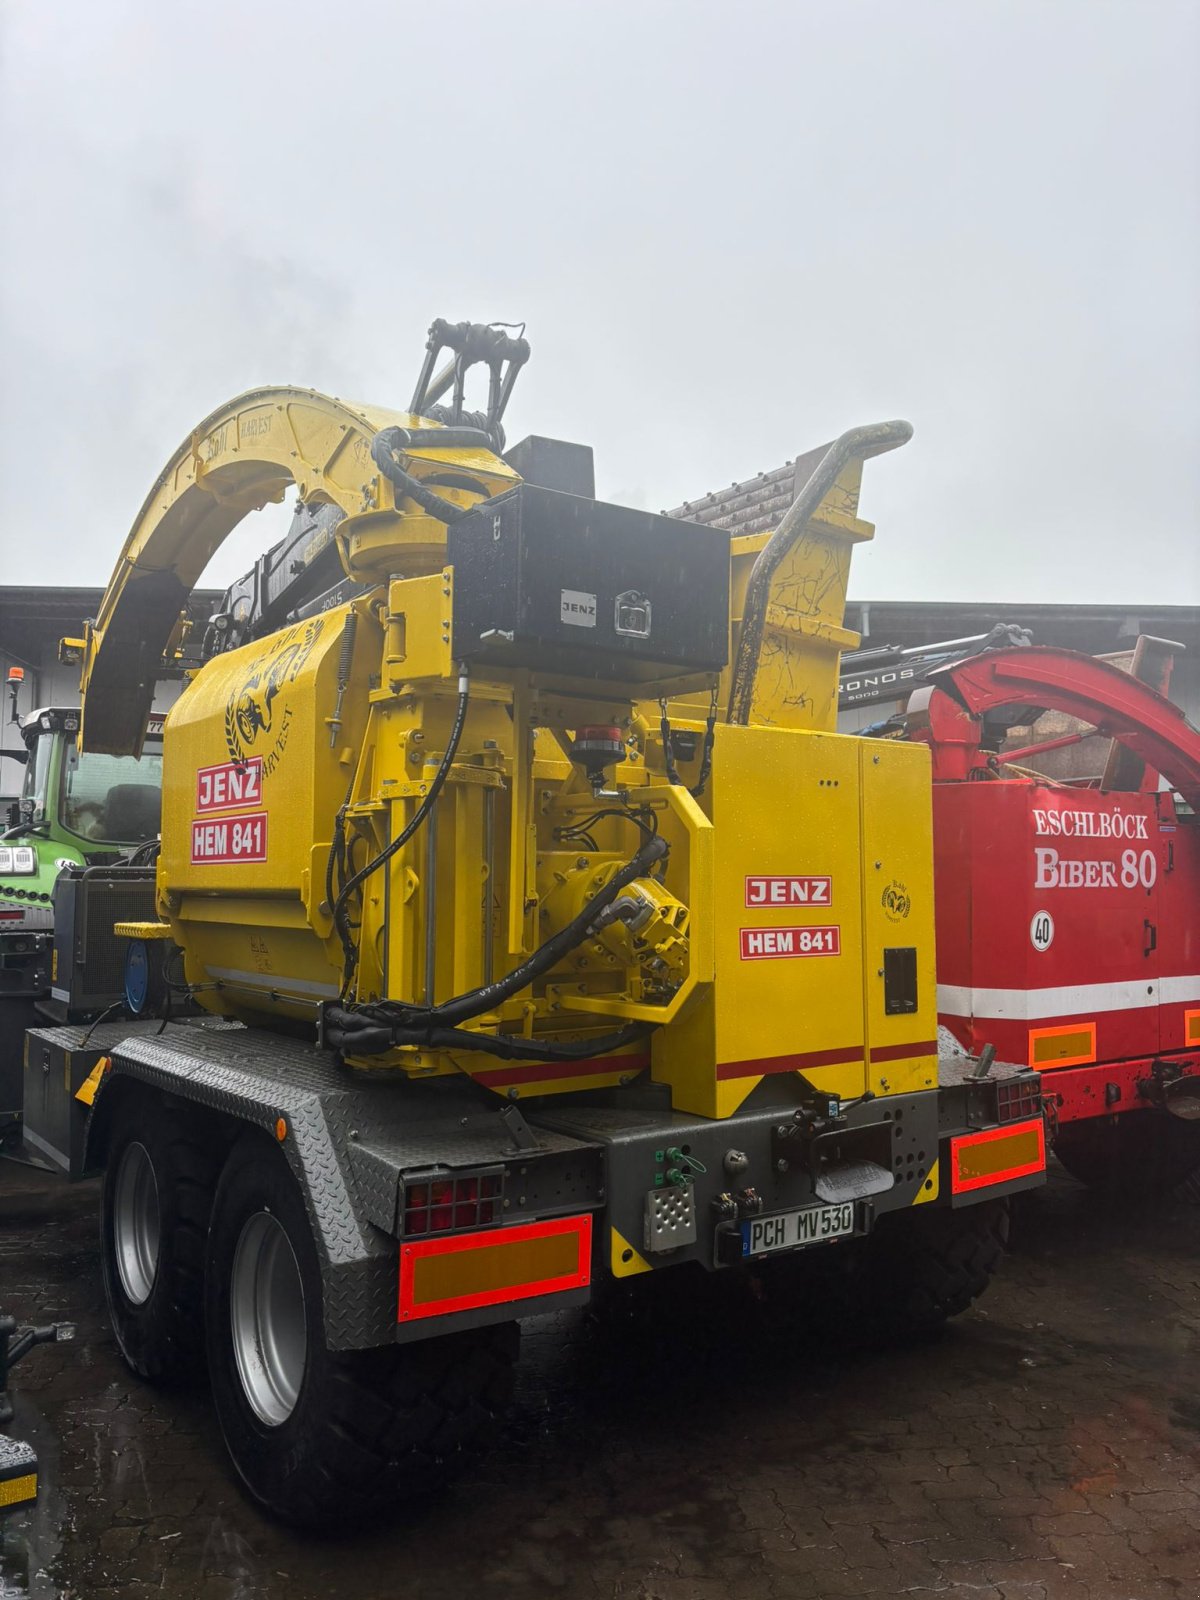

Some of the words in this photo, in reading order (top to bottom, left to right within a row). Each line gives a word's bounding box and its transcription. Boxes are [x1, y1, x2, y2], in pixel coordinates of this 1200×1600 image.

[562, 601, 596, 616] JENZ
[199, 764, 260, 806] JENZ
[193, 823, 228, 857] HEM
[231, 821, 262, 855] 841
[1032, 806, 1149, 840] ESCHLBÖCK
[1120, 848, 1157, 889] 80
[749, 880, 829, 903] JENZ
[747, 931, 794, 954] HEM
[799, 930, 834, 952] 841
[1034, 917, 1050, 944] 40
[752, 1217, 785, 1250] PCH
